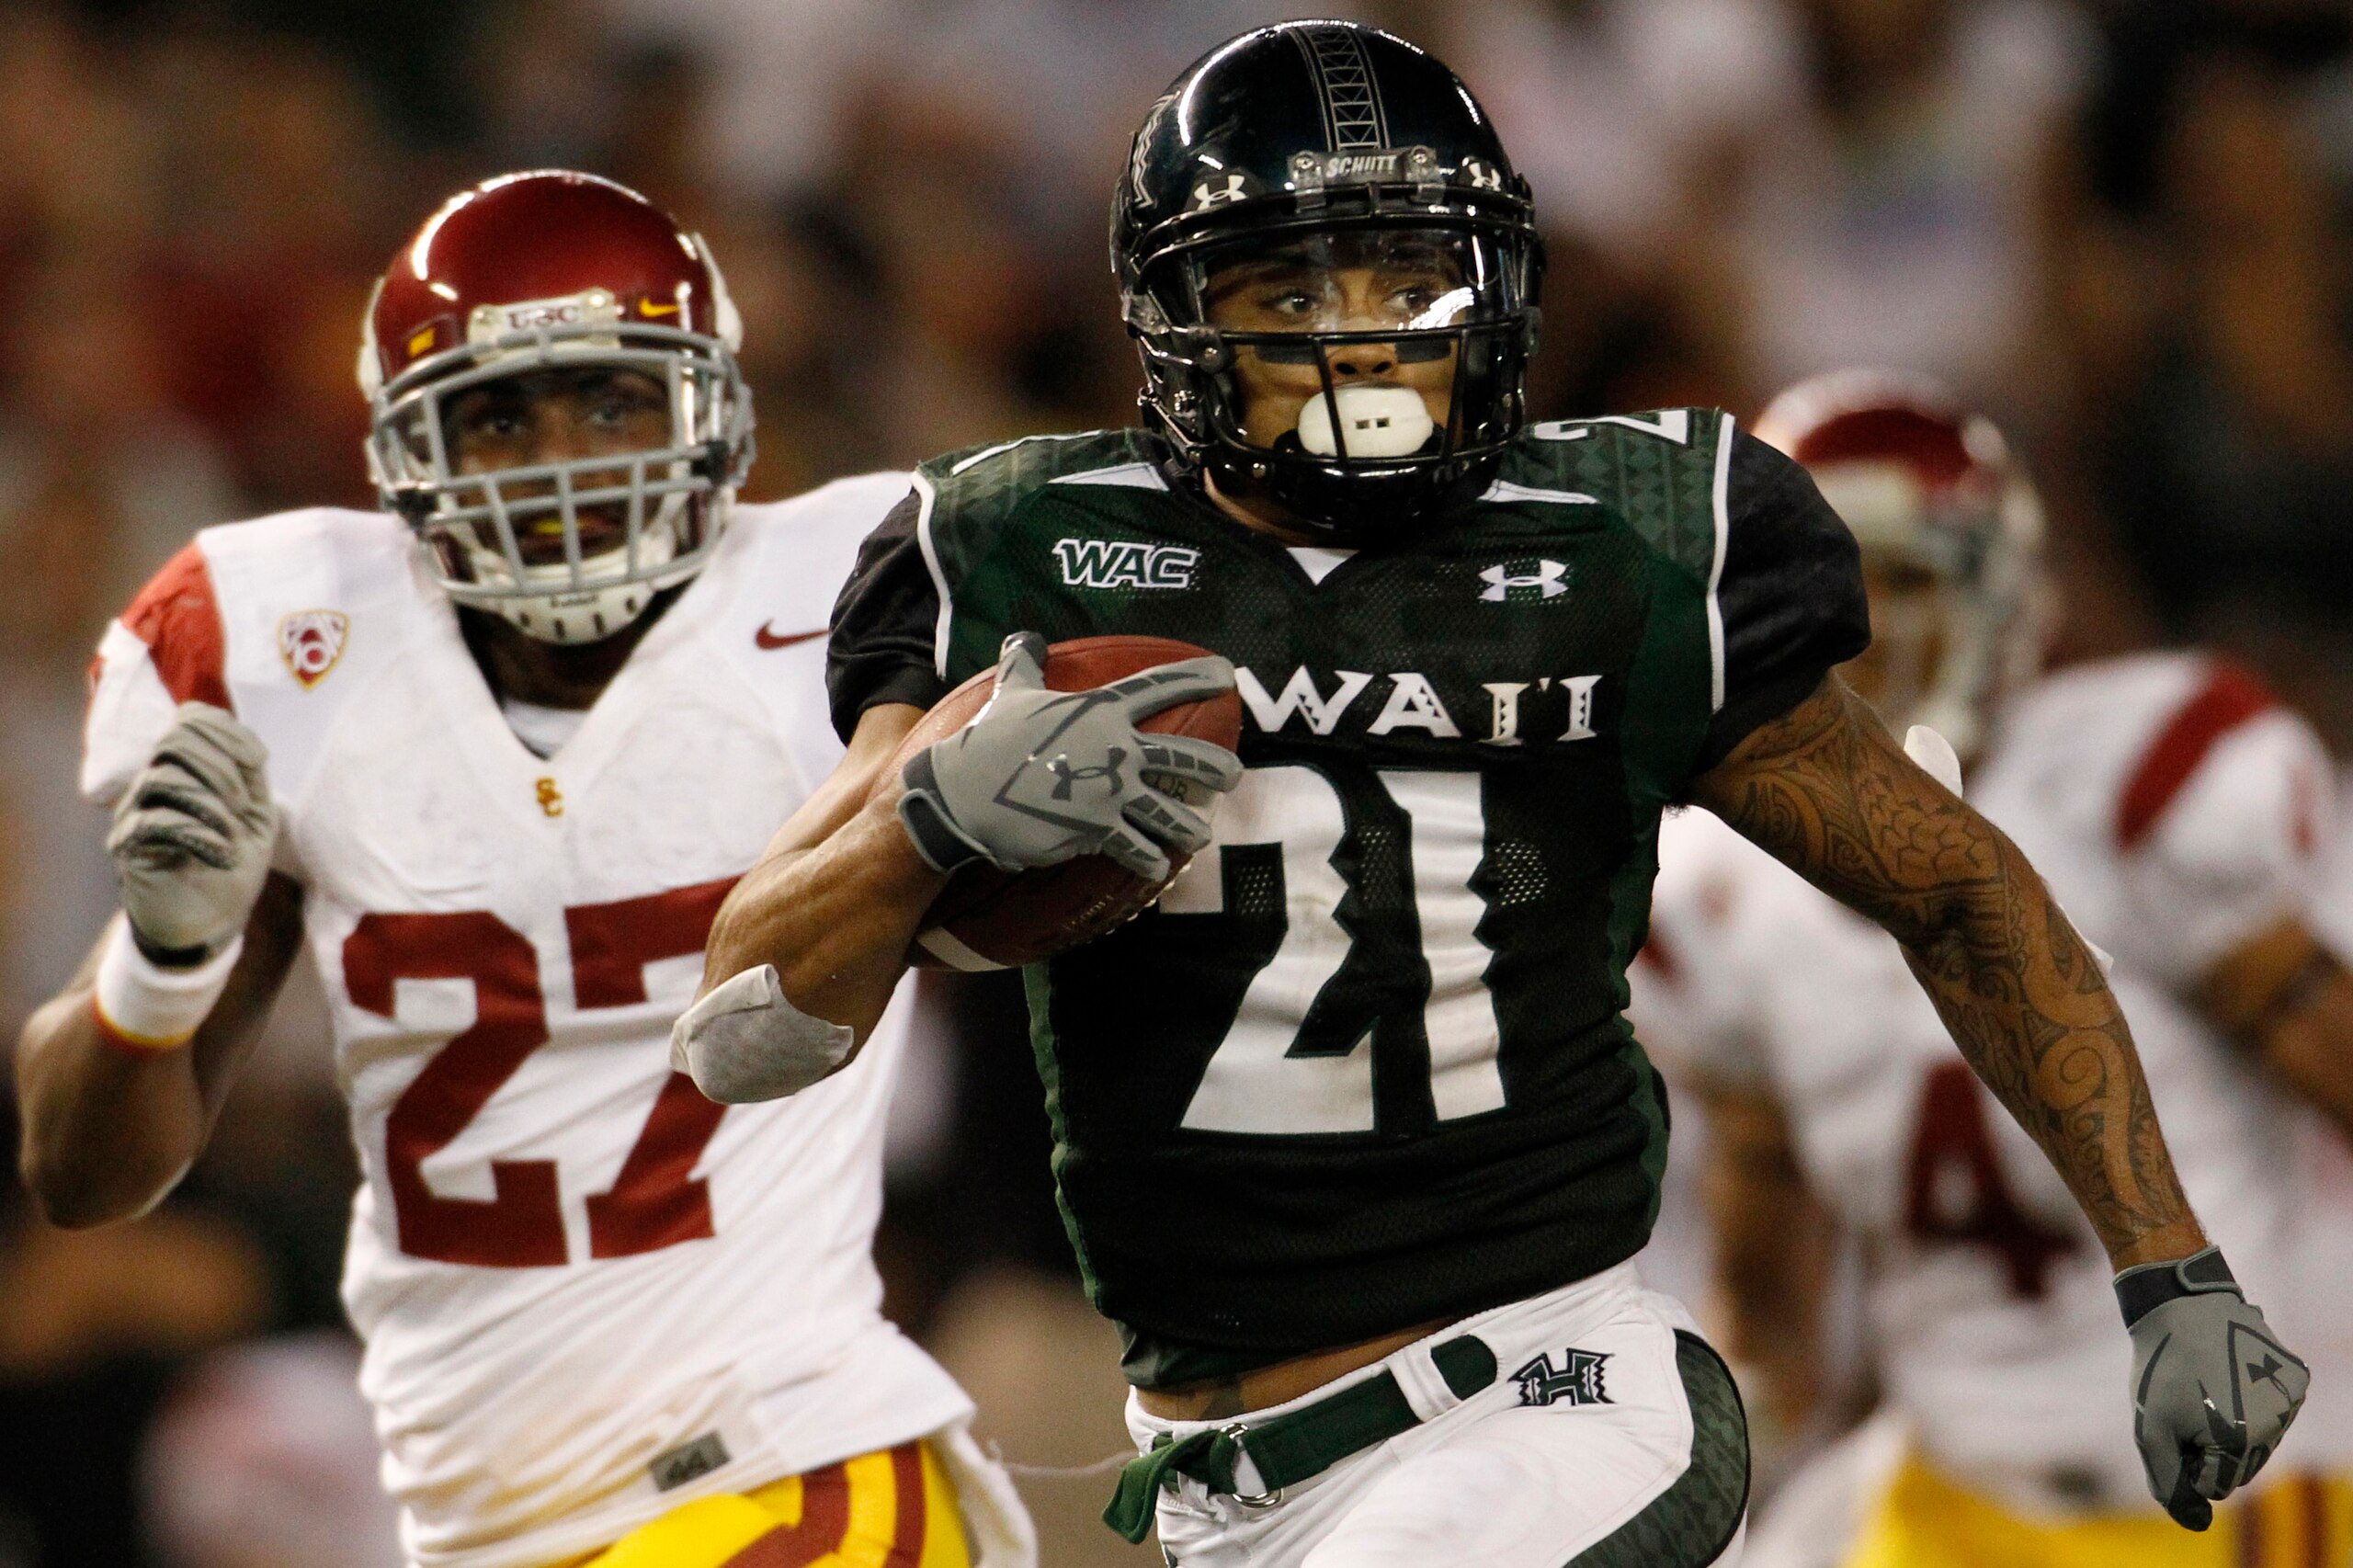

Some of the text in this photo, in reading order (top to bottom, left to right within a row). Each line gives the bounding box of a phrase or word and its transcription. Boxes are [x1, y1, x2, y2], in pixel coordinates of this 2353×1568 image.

[1325, 155, 1397, 177] SCHUTT
[1051, 539, 1199, 588] WAC
[1158, 765, 1506, 1134] 21
[342, 871, 752, 1268] 27
